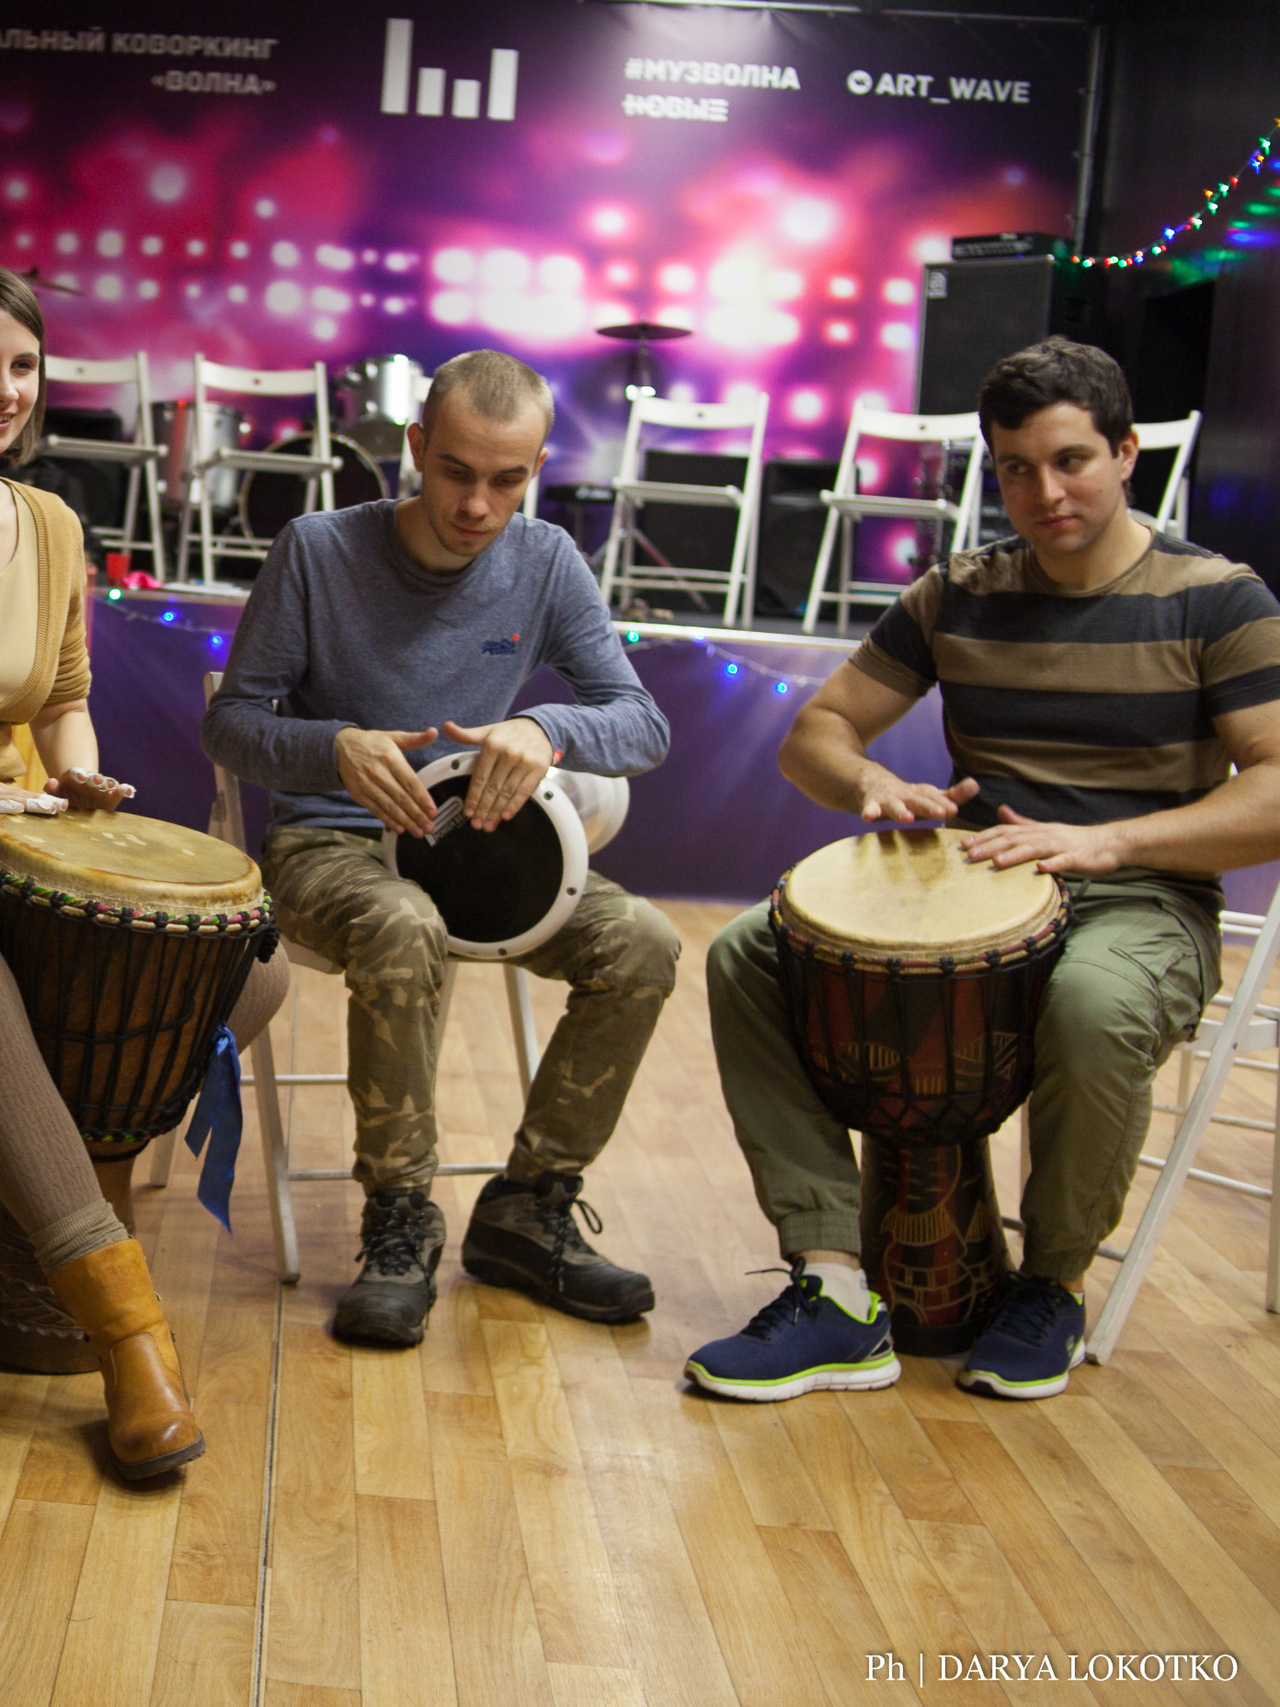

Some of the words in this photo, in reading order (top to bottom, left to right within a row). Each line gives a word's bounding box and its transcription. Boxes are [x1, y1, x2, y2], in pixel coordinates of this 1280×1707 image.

[111, 32, 278, 59] КОВОРКИНГ
[151, 70, 276, 95] «ВОЛНА»
[624, 57, 801, 90] #МУЗВОЛНА
[875, 72, 1031, 104] ART_WAVE
